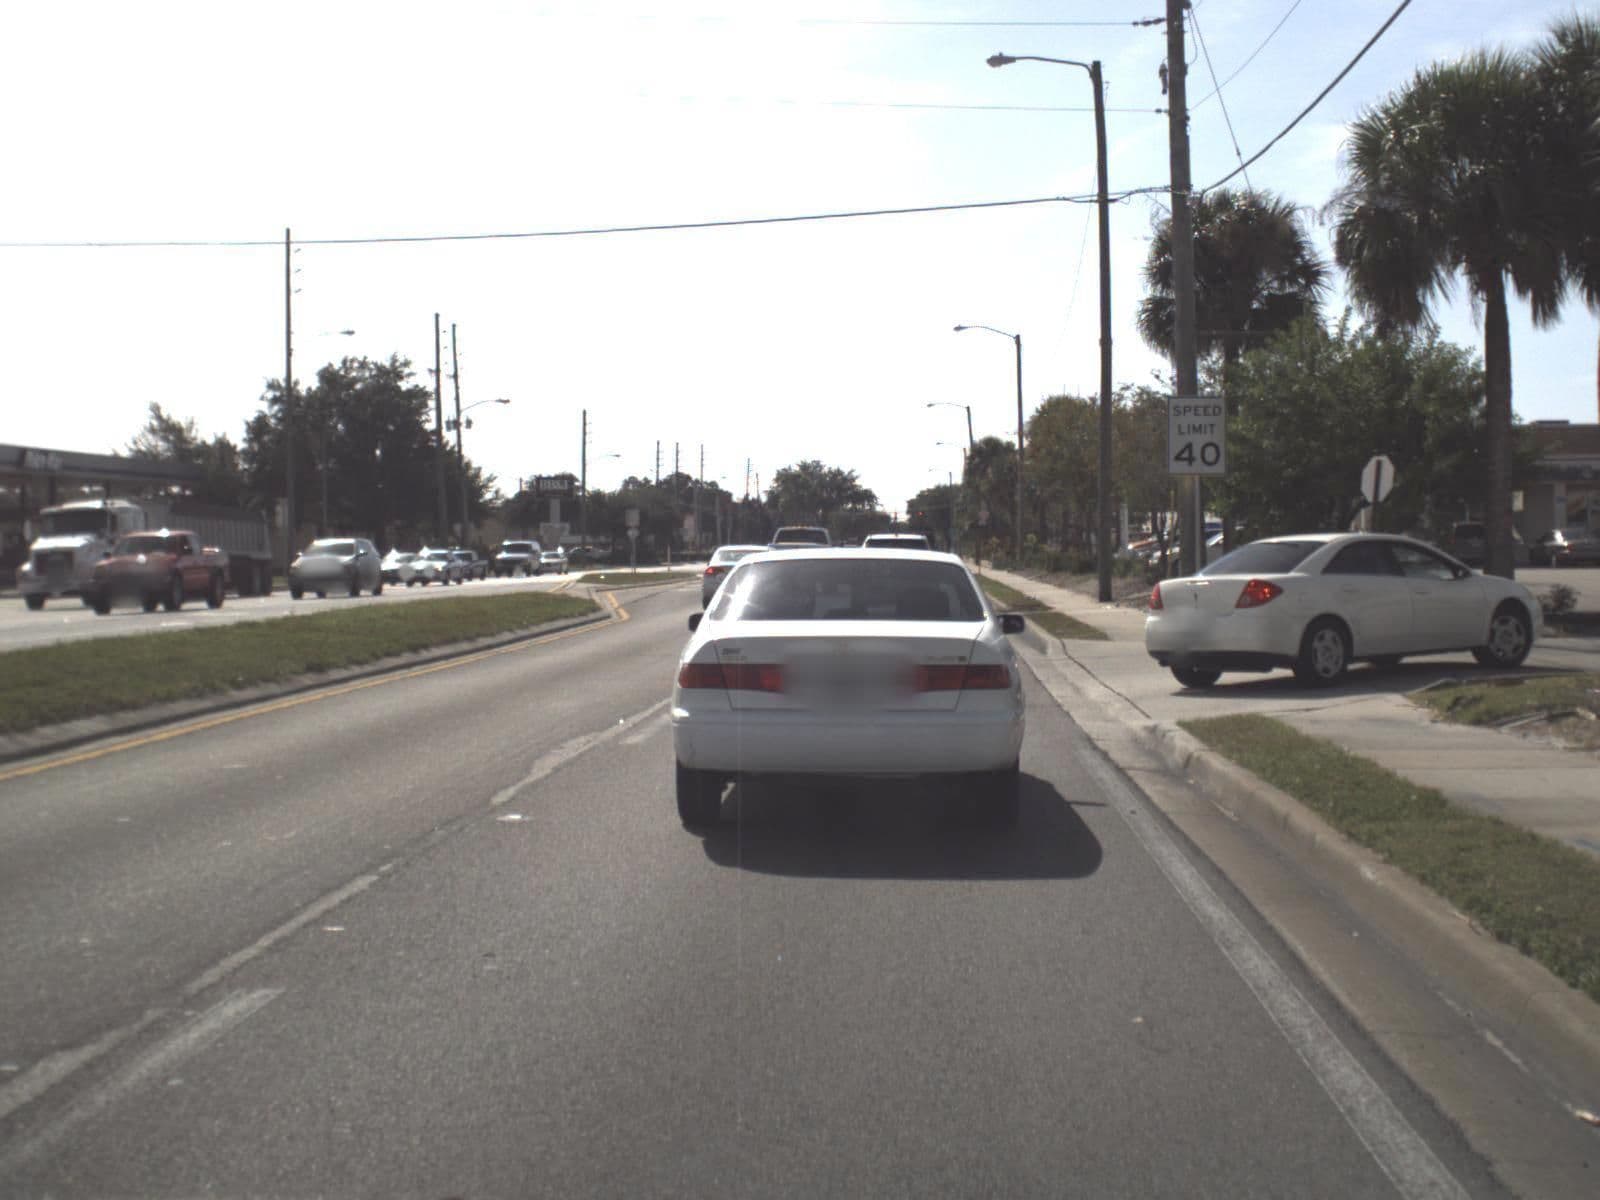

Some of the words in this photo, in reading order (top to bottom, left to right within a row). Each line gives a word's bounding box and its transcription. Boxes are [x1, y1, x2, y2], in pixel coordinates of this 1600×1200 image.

[1173, 405, 1222, 416] SPEED
[1177, 423, 1216, 435] LIMIT
[1174, 442, 1220, 467] 40
